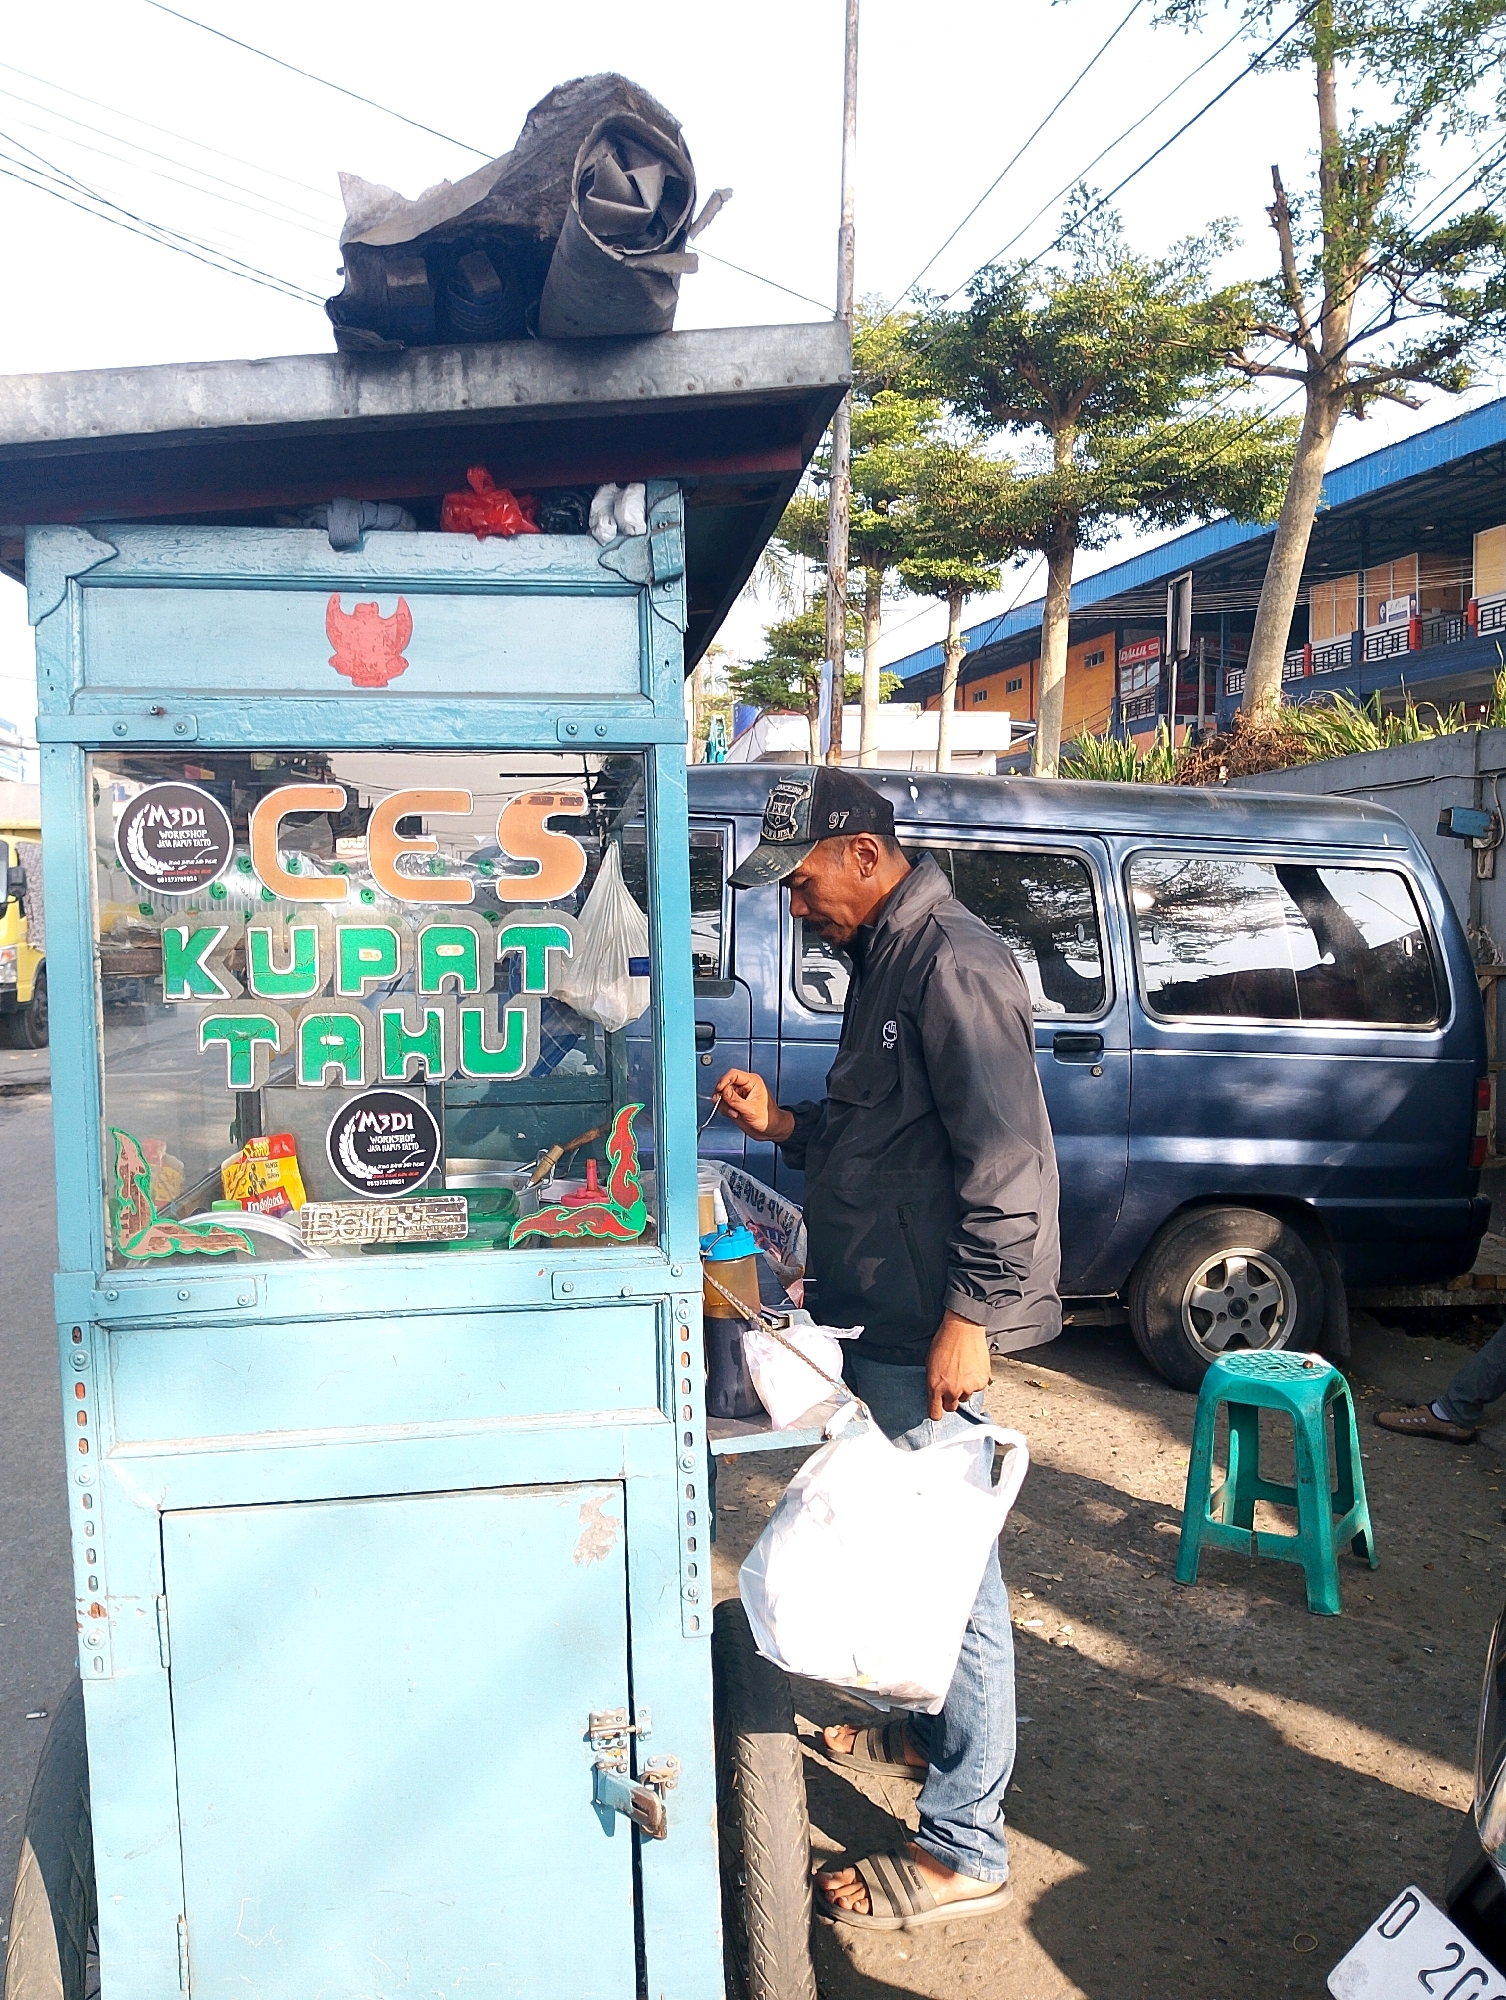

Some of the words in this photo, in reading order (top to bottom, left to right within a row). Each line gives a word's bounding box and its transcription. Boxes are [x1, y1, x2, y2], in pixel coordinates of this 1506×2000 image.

[159, 829, 208, 840] WORKSHOP
[249, 783, 588, 904] CES
[828, 810, 850, 830] 97
[162, 922, 574, 1000] KUPAT
[199, 1006, 528, 1090] TAHU
[369, 1133, 416, 1145] WORKSHOP
[1377, 1891, 1420, 1939] D
